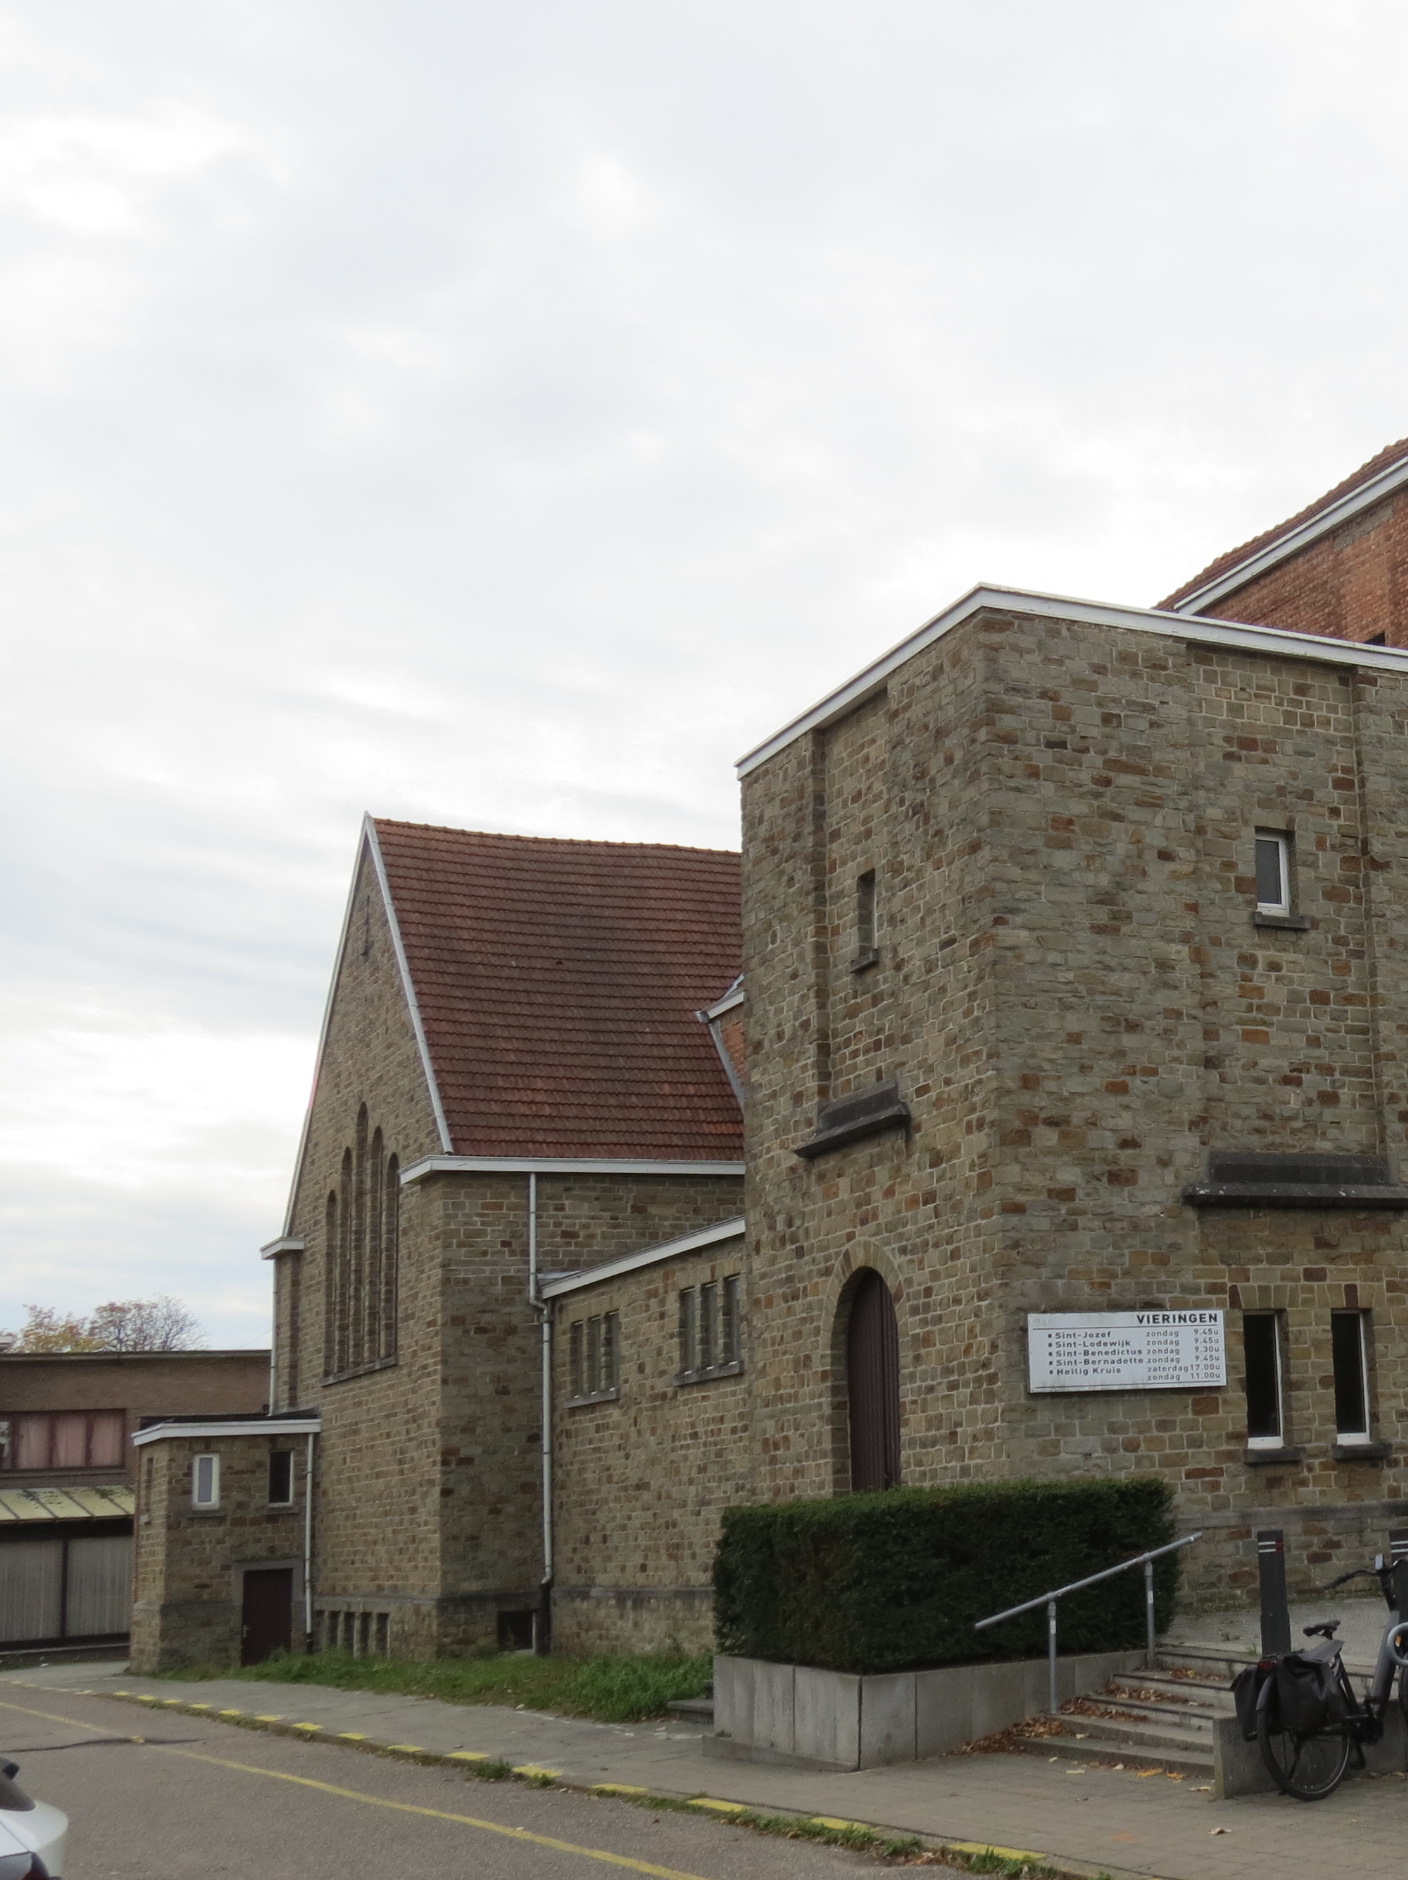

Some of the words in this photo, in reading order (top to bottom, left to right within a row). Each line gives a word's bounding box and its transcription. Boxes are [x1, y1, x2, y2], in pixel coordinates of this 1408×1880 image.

[1137, 1313, 1218, 1324] VIERINGEN
[1055, 1331, 1111, 1339] Sint-Jozef
[1055, 1340, 1131, 1348] Sint-Lodewijk
[1055, 1348, 1142, 1357] Sint-Benedictus
[1055, 1357, 1143, 1366] Sint-Bernadette
[1147, 1356, 1180, 1364] zondag
[1056, 1367, 1089, 1376] Heilig
[1092, 1366, 1121, 1374] Kruis
[1147, 1365, 1189, 1373] zaterdag
[1190, 1363, 1220, 1371] 17.00u
[1147, 1373, 1181, 1381] zondag
[1190, 1372, 1220, 1380] 11.00u
